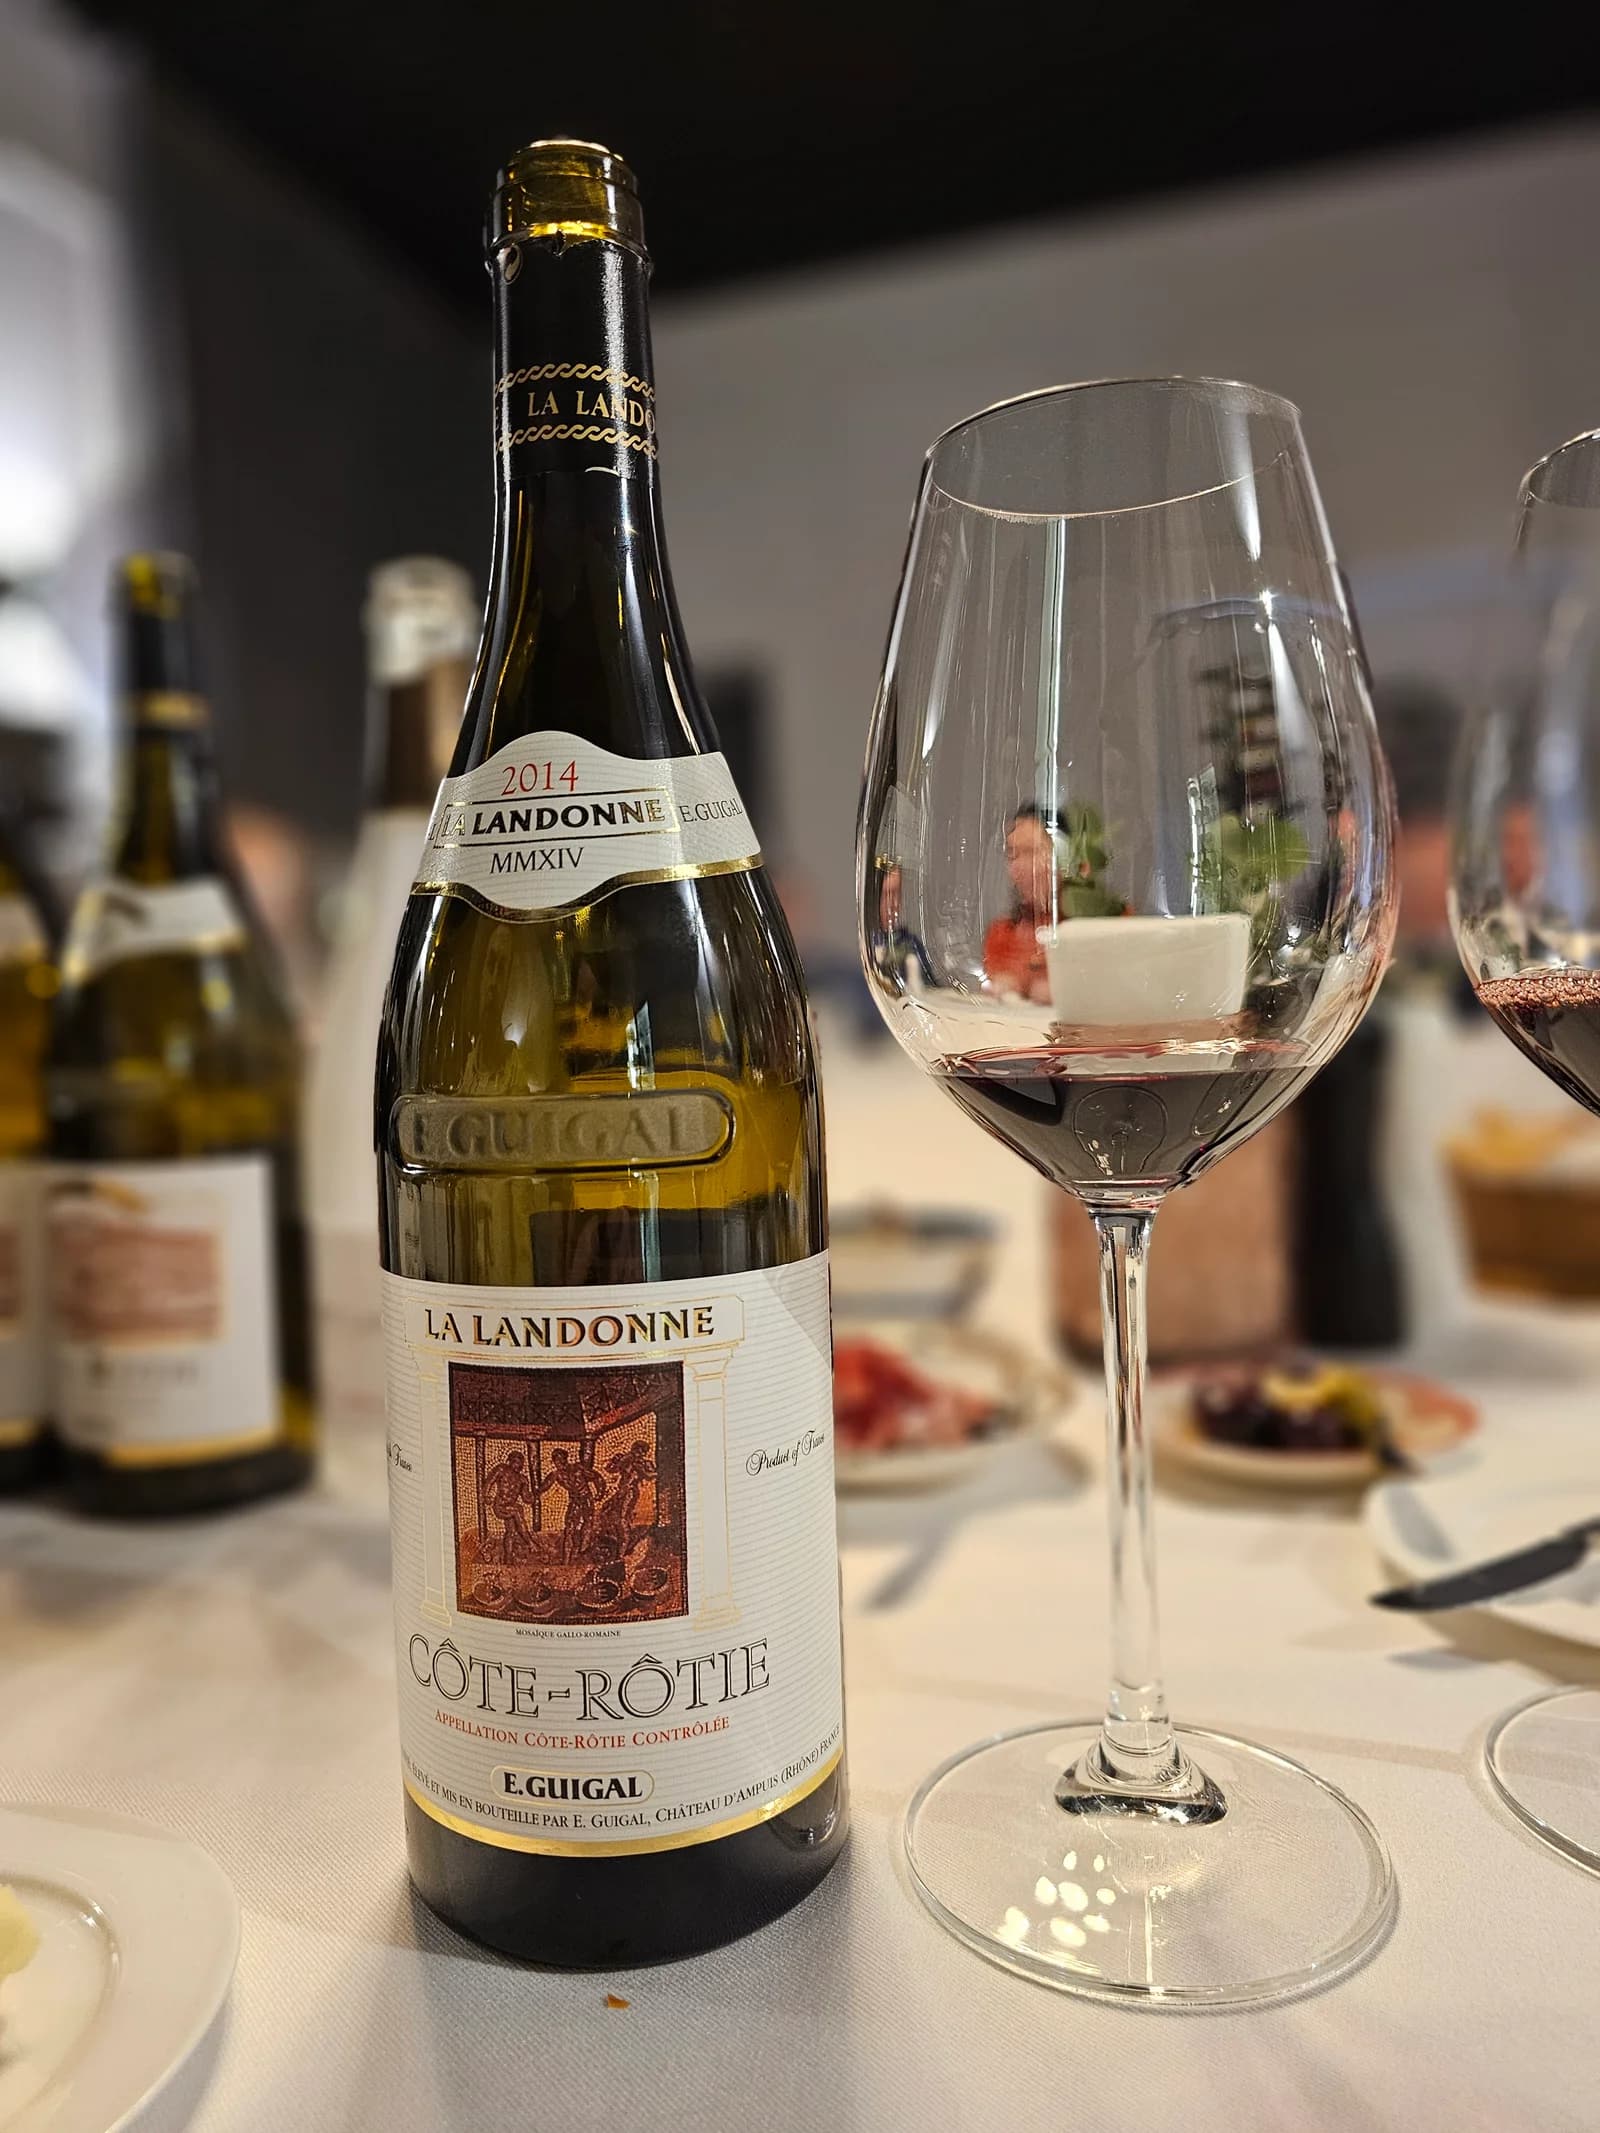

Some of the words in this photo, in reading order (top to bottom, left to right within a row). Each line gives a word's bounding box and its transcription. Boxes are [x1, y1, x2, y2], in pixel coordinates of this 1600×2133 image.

[528, 390, 559, 417] LA
[501, 760, 579, 796] 2014
[441, 813, 466, 838] LA
[471, 799, 665, 836] LANDONNE
[490, 847, 584, 874] MMXIV
[425, 1308, 463, 1343] LA
[472, 1305, 714, 1348] LANDONNE
[409, 1633, 771, 1721] CÔTE-RÔTIE
[434, 1708, 518, 1746] APPELLATION
[524, 1731, 626, 1750] CÔTE-RÔTIE
[632, 1715, 730, 1748] CONTRÔLÉE
[442, 1786, 457, 1803] MIS
[459, 1795, 473, 1811] EN
[475, 1801, 540, 1826] BOUTEILLE
[543, 1815, 568, 1828] PAR
[573, 1815, 586, 1829] E.
[592, 1811, 651, 1829] GUIGAL,
[655, 1796, 721, 1824] CHÂTEAU
[723, 1773, 779, 1808] D'AMPUIS
[504, 1771, 643, 1800] E.GUIGAL
